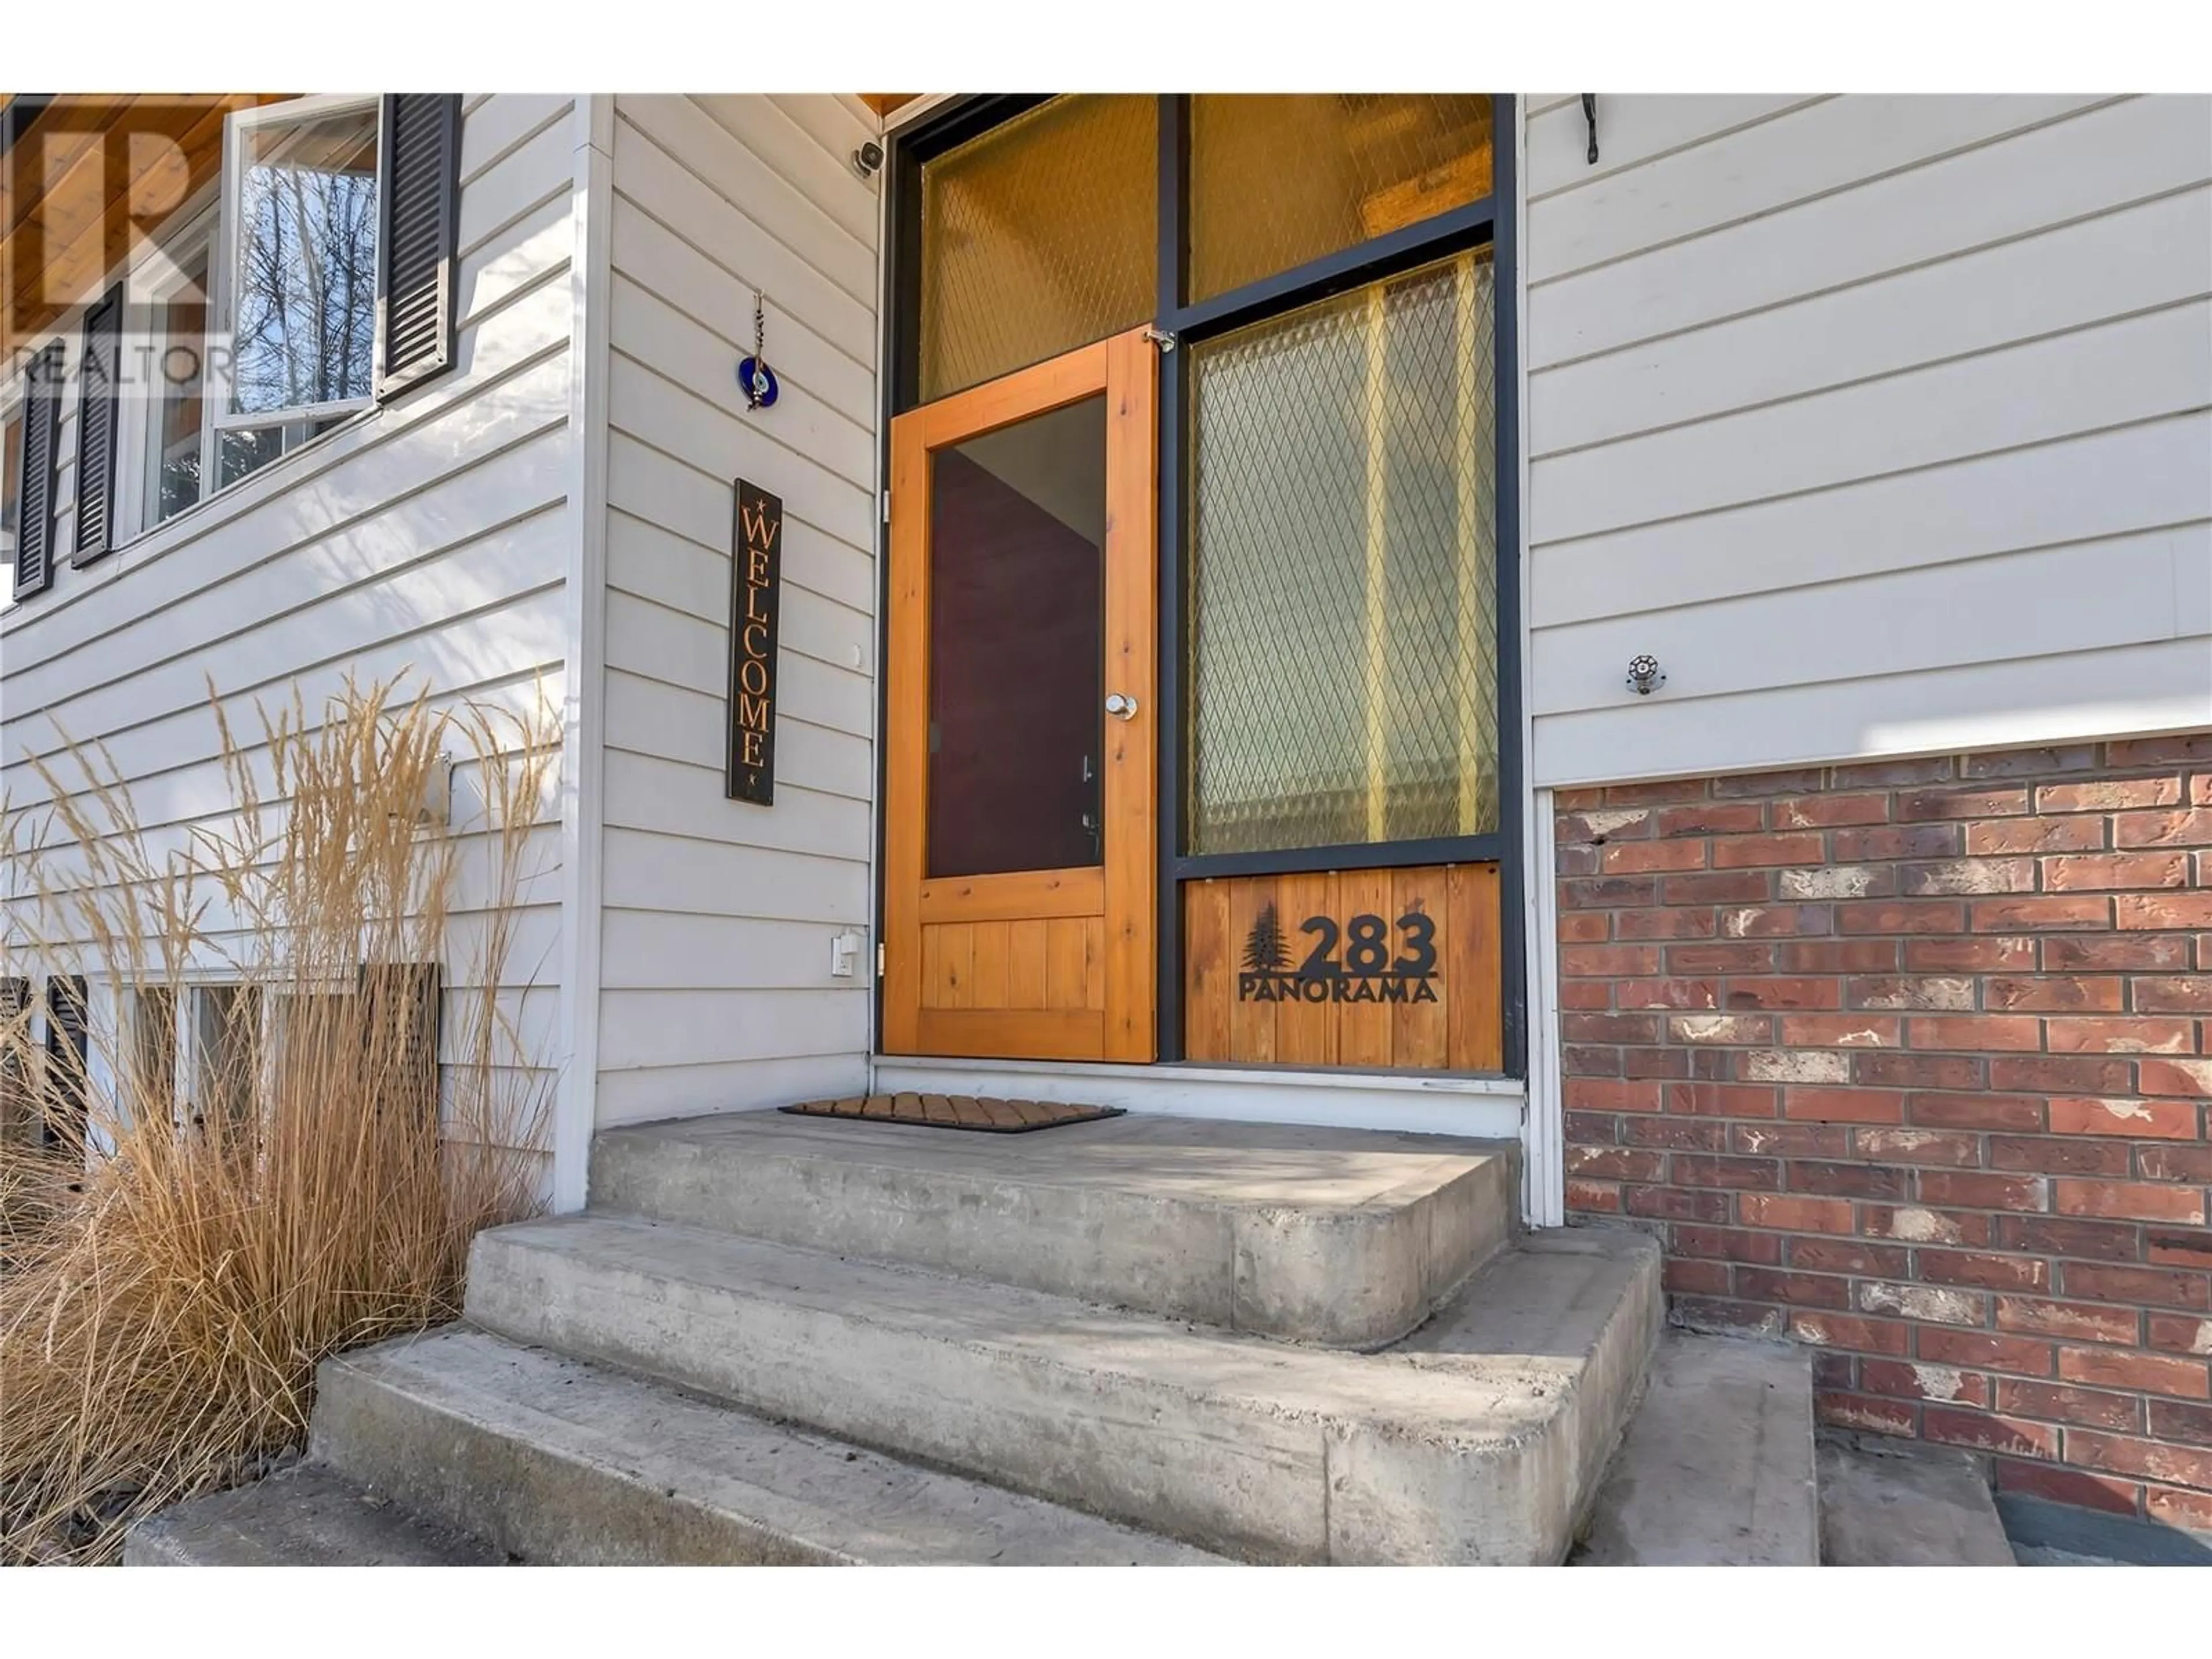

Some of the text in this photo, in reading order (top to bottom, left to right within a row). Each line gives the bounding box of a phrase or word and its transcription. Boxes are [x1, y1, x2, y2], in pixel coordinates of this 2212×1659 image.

[737, 505, 779, 767] WELCOME
[1300, 913, 1438, 975] 283
[1238, 976, 1438, 1003] PANORAMA
